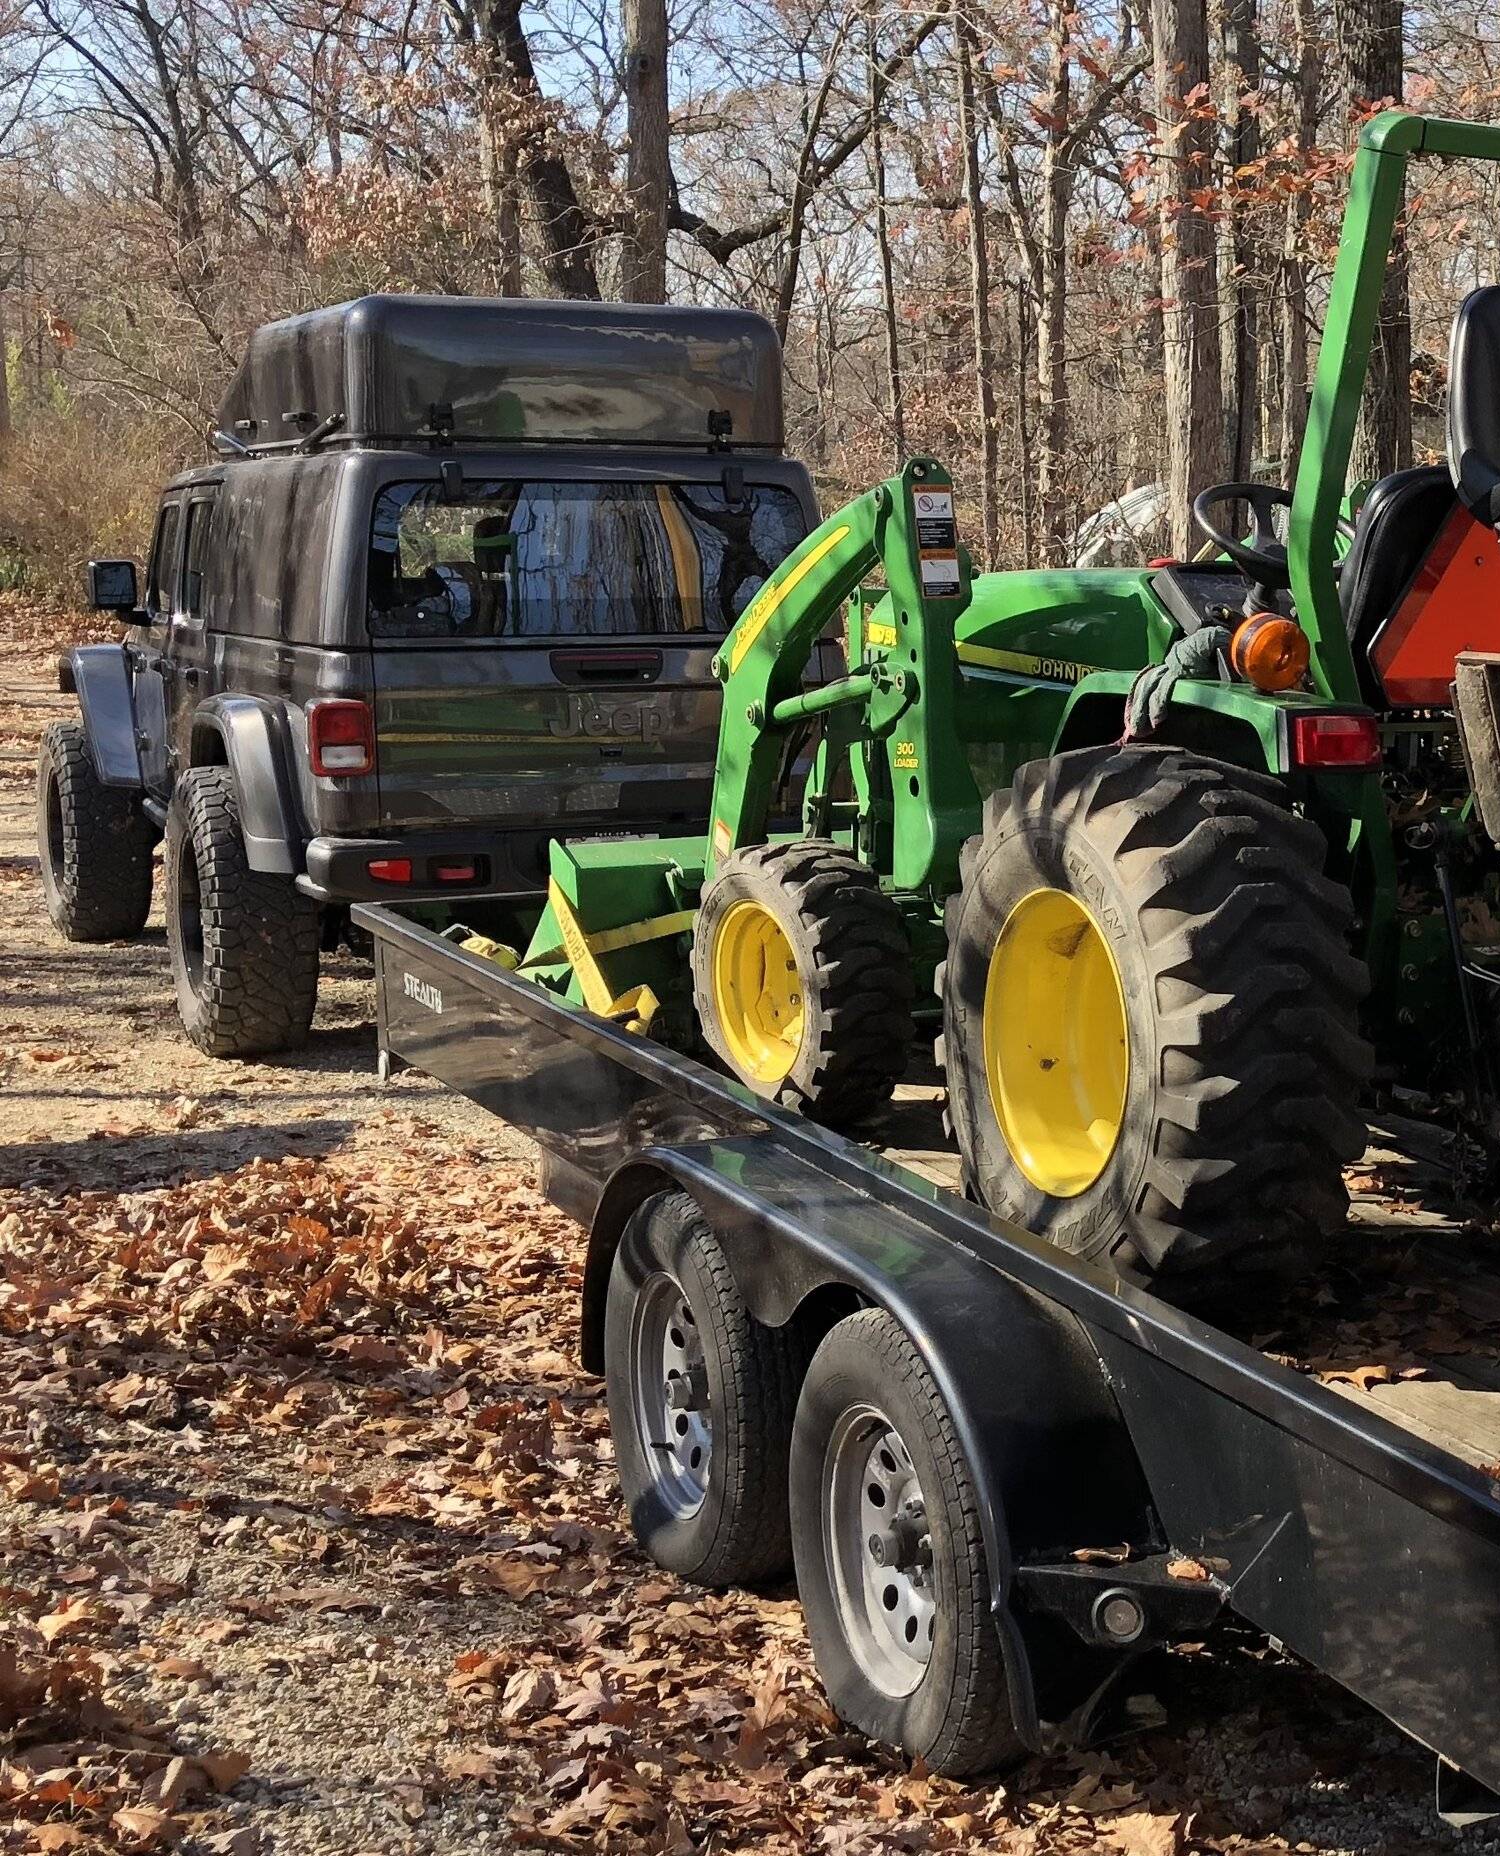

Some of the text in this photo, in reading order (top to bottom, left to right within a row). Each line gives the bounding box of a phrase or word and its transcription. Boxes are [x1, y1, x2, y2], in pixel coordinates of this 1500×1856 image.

[1032, 657, 1076, 682] JOHN
[548, 693, 670, 742] Jeep
[896, 742, 915, 756] 300
[893, 757, 919, 769] LOADER
[403, 972, 443, 1015] STEALTH
